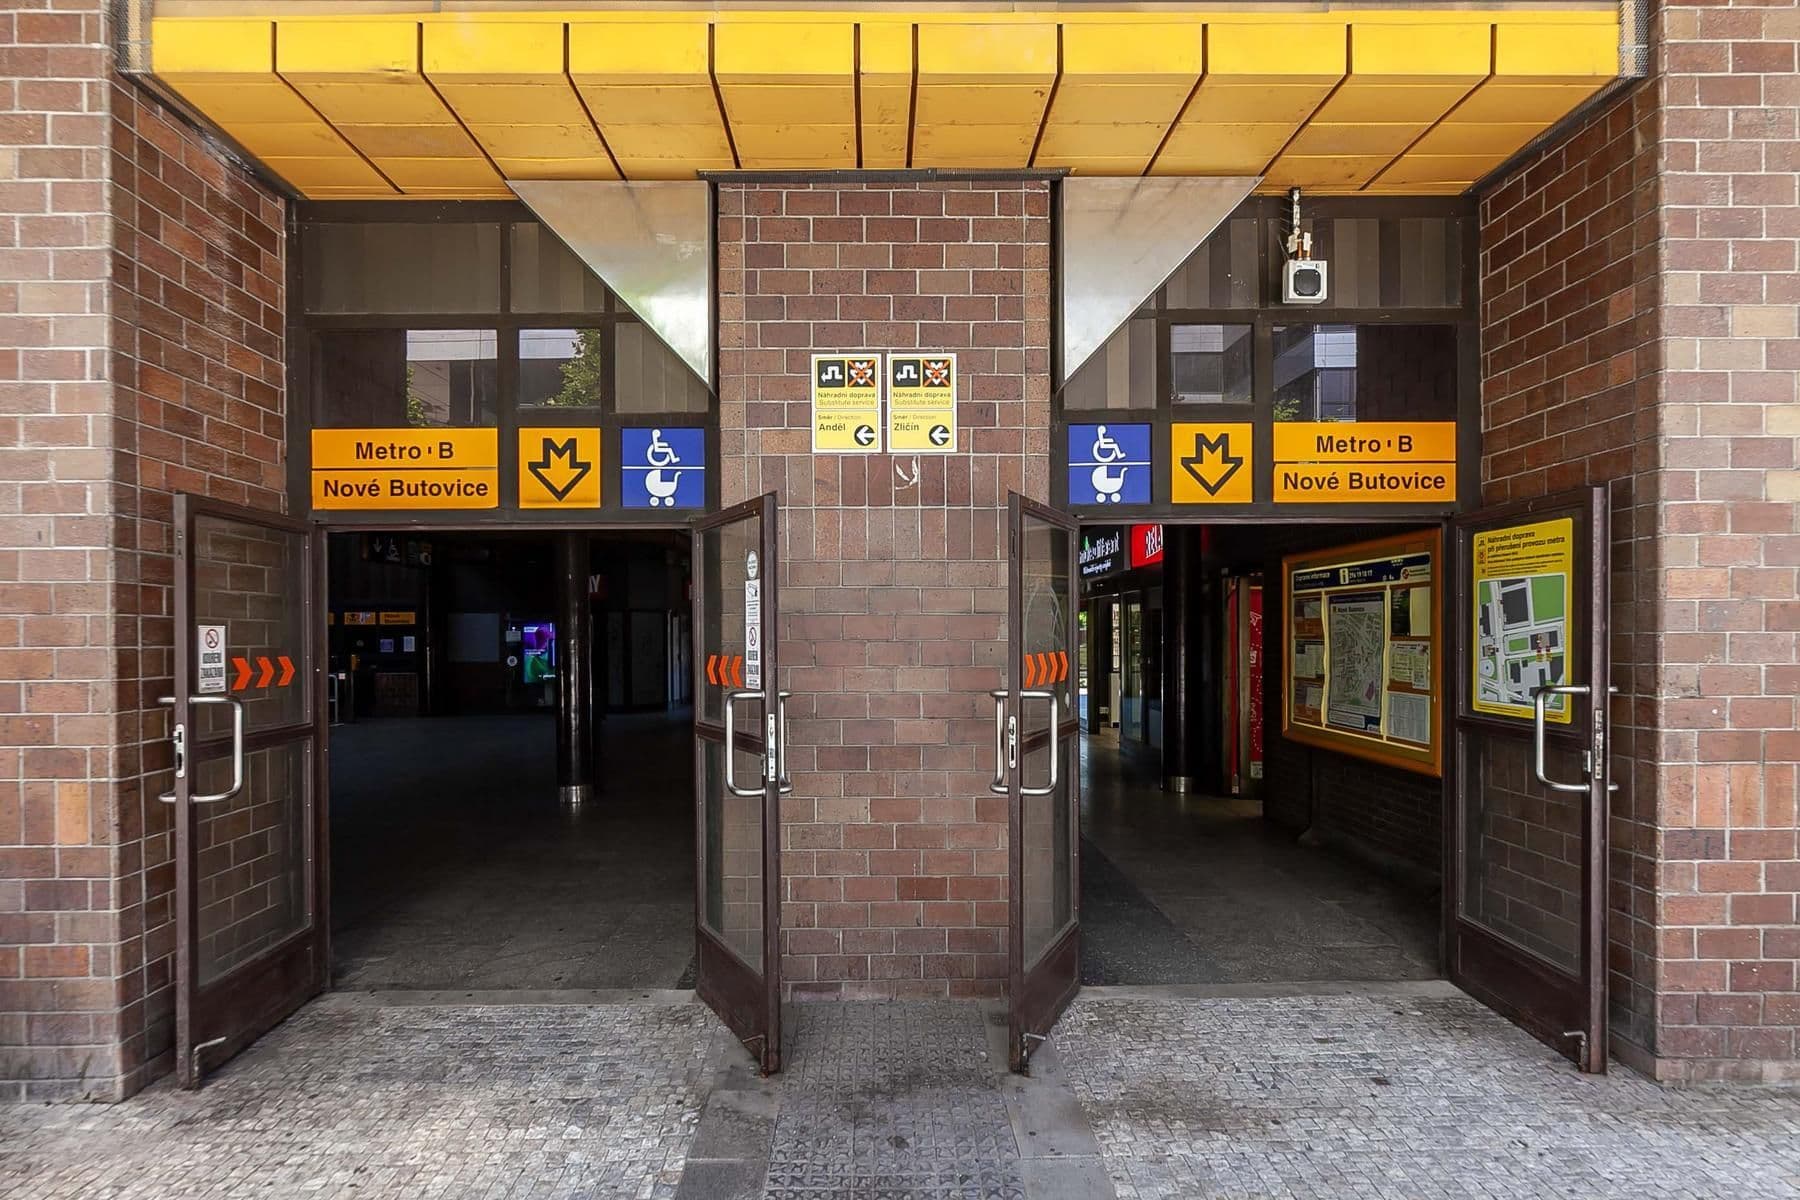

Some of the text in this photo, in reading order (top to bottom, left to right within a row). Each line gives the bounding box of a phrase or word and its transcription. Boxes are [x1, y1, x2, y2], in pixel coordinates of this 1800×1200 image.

[818, 422, 846, 431] Anděl
[894, 422, 920, 431] Zličín
[356, 442, 454, 459] Metro B
[1316, 436, 1413, 453] Metro B
[324, 478, 488, 497] Nové Butovice
[1284, 472, 1446, 490] Nové Butovice
[1512, 532, 1535, 540] doprava
